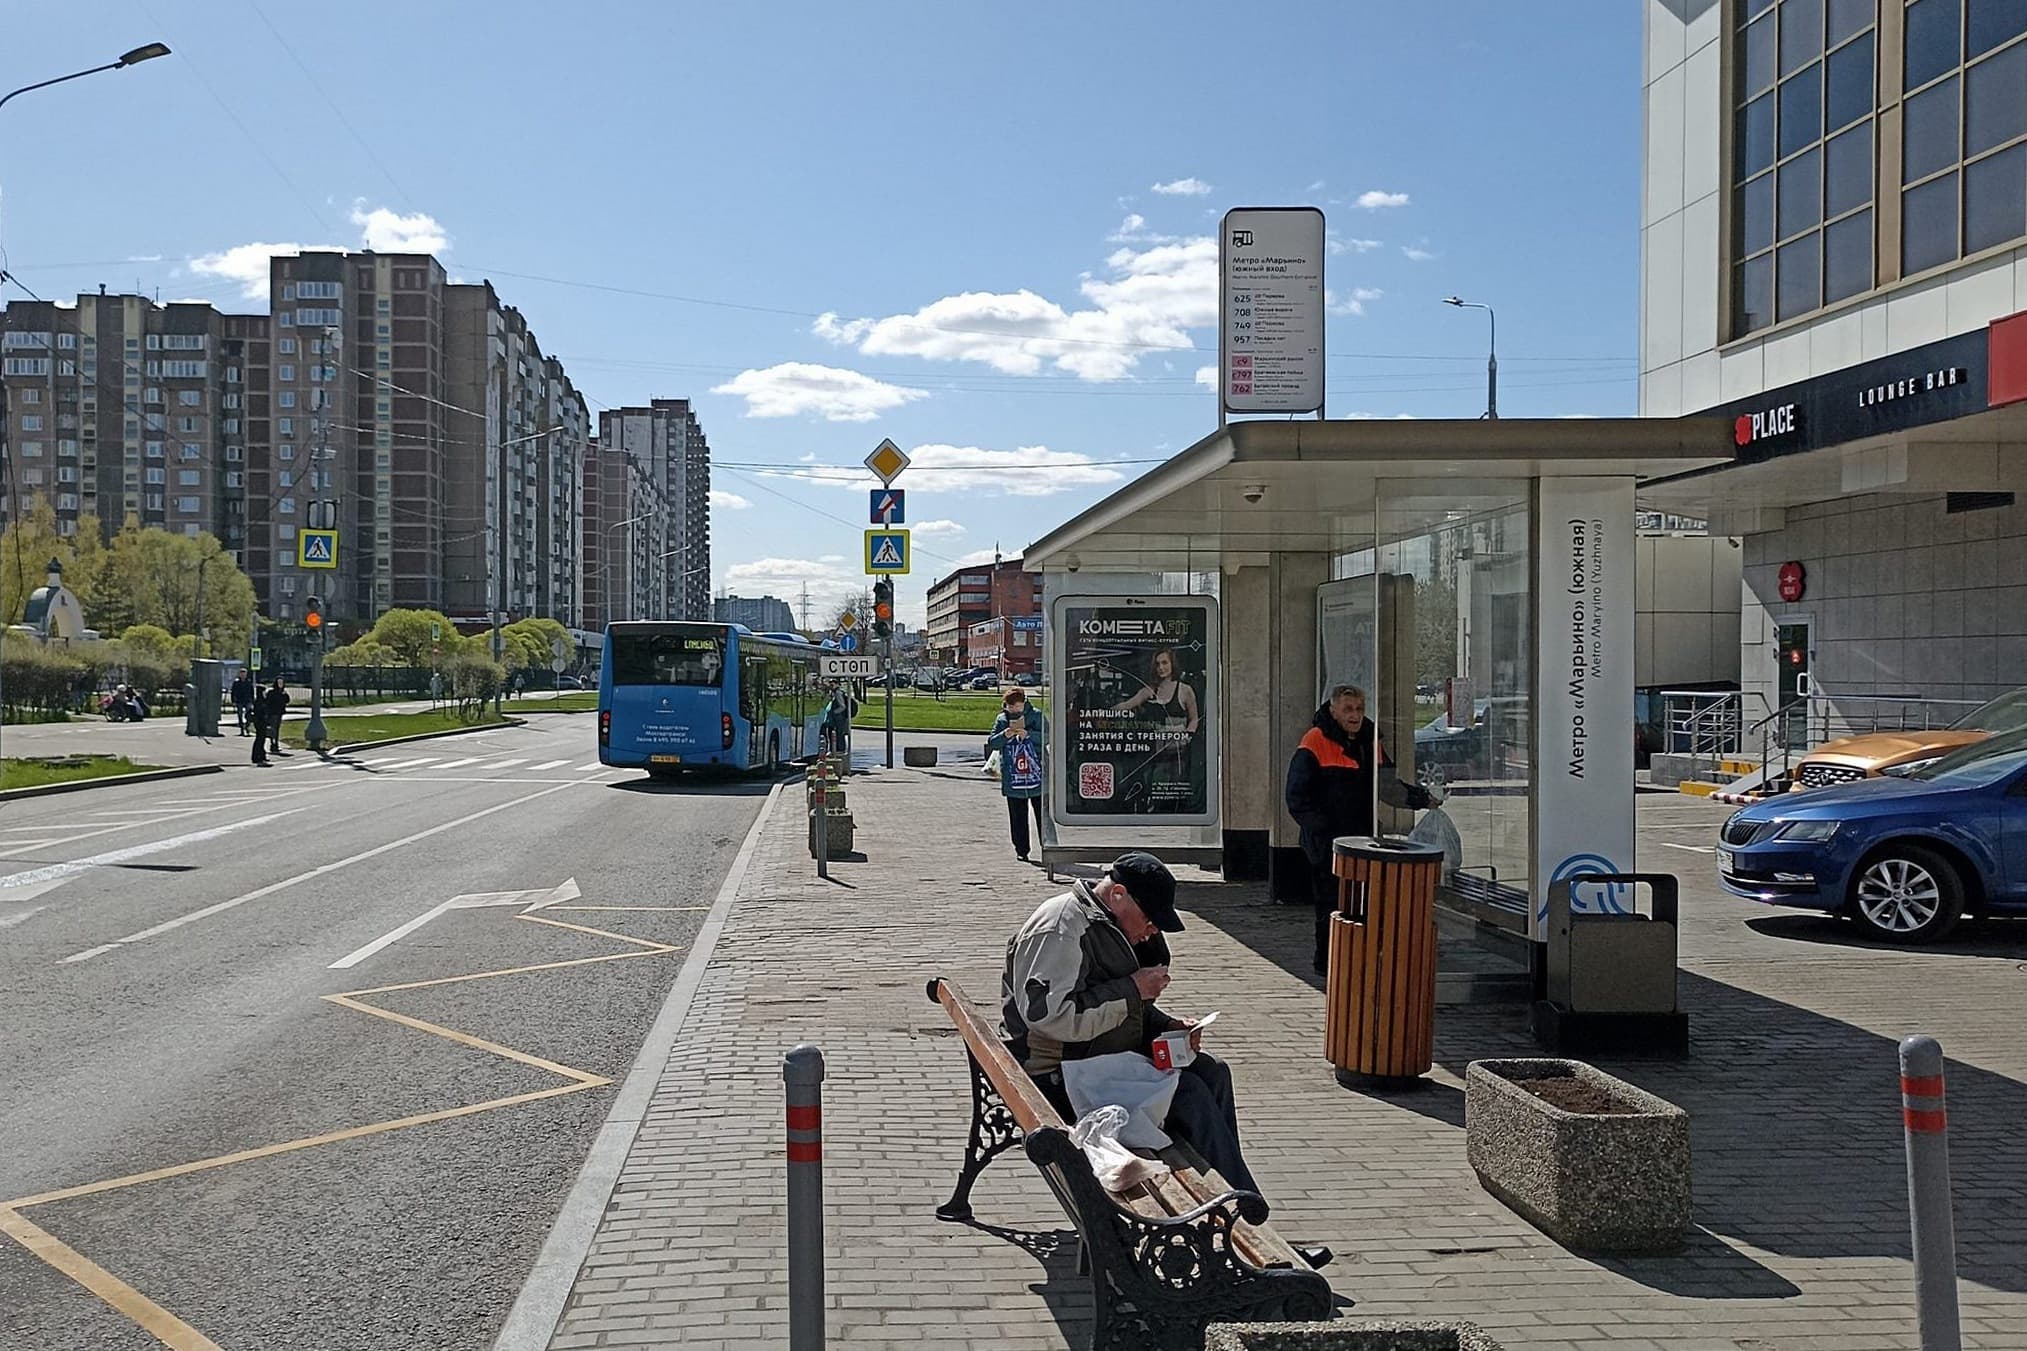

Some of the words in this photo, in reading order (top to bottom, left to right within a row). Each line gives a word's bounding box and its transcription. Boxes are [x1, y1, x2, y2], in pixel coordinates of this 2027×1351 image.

[1232, 256, 1259, 265] Метро
[1234, 295, 1251, 303] 625
[1234, 308, 1251, 317] 708
[1233, 335, 1251, 344] 957
[1232, 384, 1251, 393] 762
[1859, 378, 1915, 407] LOUNGE
[1926, 367, 1957, 390] BAR
[1752, 403, 1795, 441] PLACE
[1568, 519, 1586, 594] (южная)
[1591, 587, 1603, 638] Maryino
[1569, 600, 1587, 710] «Марьино»
[1591, 640, 1602, 678] Metro
[828, 660, 869, 674] СТОП
[1079, 709, 1135, 718] ЗАПИШИСЬ
[1079, 720, 1093, 729] НА
[1079, 732, 1124, 740] ЗАНЯТИЯ
[1126, 732, 1134, 740] С
[1079, 743, 1085, 752] 2
[1087, 743, 1113, 752] РАЗА
[1115, 743, 1122, 752] В
[1124, 743, 1151, 753] ДЕНЬ
[1568, 714, 1587, 779] Метро
